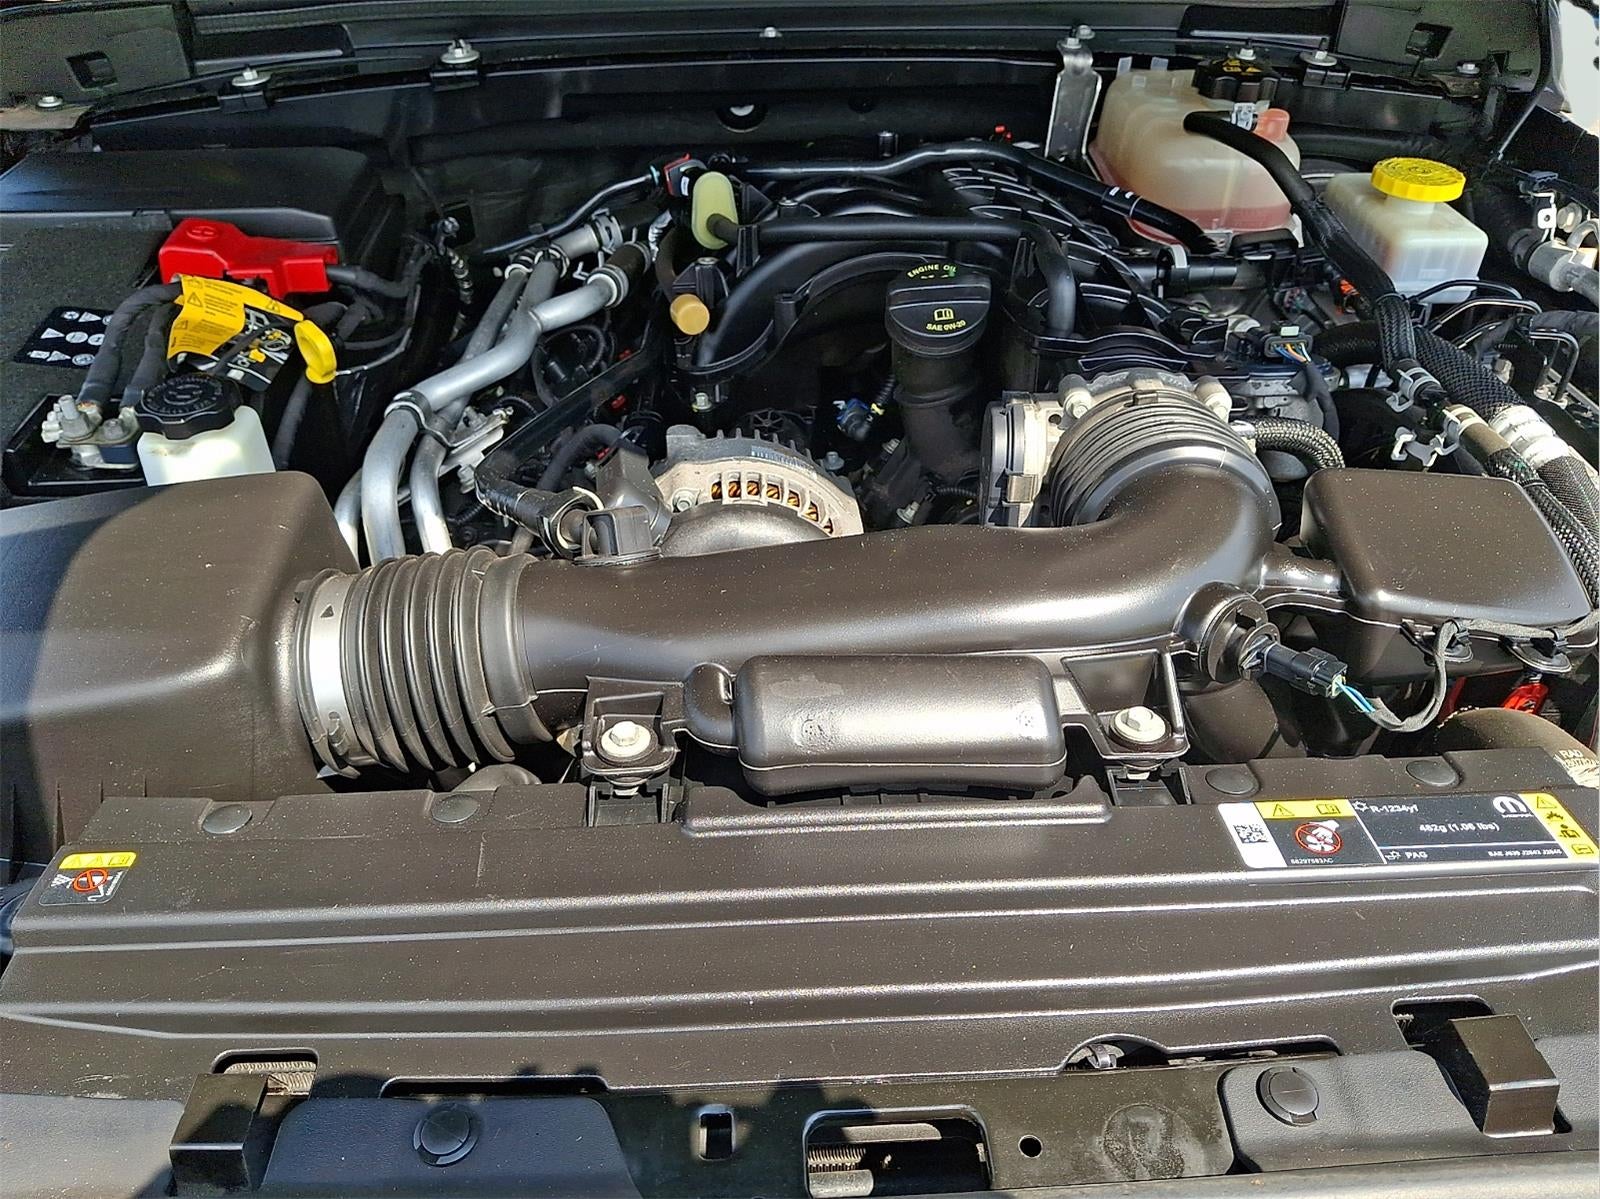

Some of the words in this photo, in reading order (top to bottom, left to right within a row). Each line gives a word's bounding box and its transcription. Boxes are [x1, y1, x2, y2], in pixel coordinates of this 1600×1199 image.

[907, 264, 940, 278] ENGINE
[943, 264, 957, 273] OIL
[926, 323, 943, 332] SAE
[1477, 822, 1500, 832] lbs)
[1404, 851, 1428, 859] PAG
